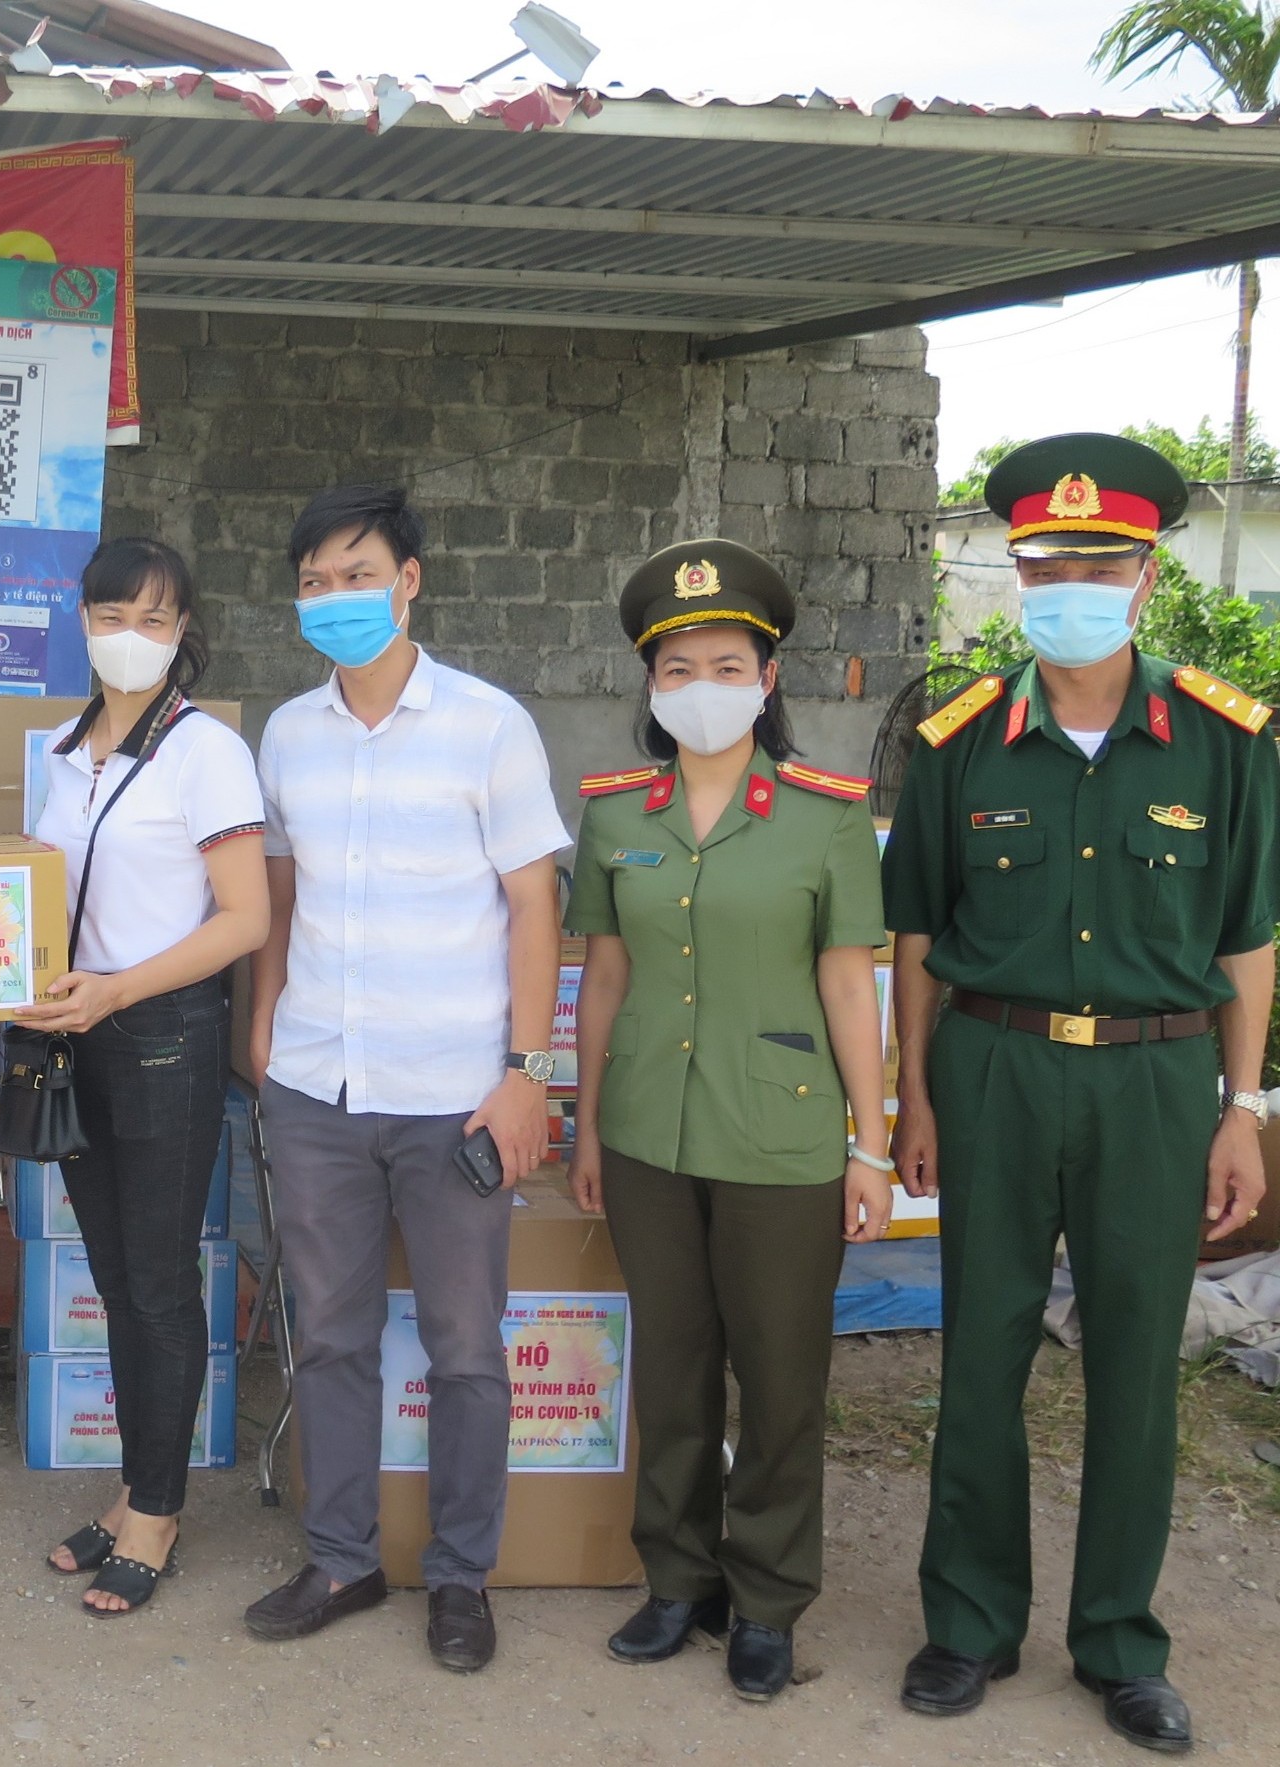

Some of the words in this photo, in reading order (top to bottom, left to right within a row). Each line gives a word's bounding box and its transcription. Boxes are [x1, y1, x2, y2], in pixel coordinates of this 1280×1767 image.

[7, 327, 33, 342] DỊCH
[27, 364, 39, 379] 8
[4, 556, 11, 567] 3
[3, 591, 12, 601] y
[13, 586, 23, 600] tế
[26, 589, 48, 604] điện
[51, 592, 64, 603] tử
[516, 1341, 550, 1371] HỘ
[528, 1380, 563, 1396] VĨNH
[567, 1377, 596, 1396] BẢO
[101, 1413, 114, 1422] AN
[538, 1405, 600, 1420] COVID-19
